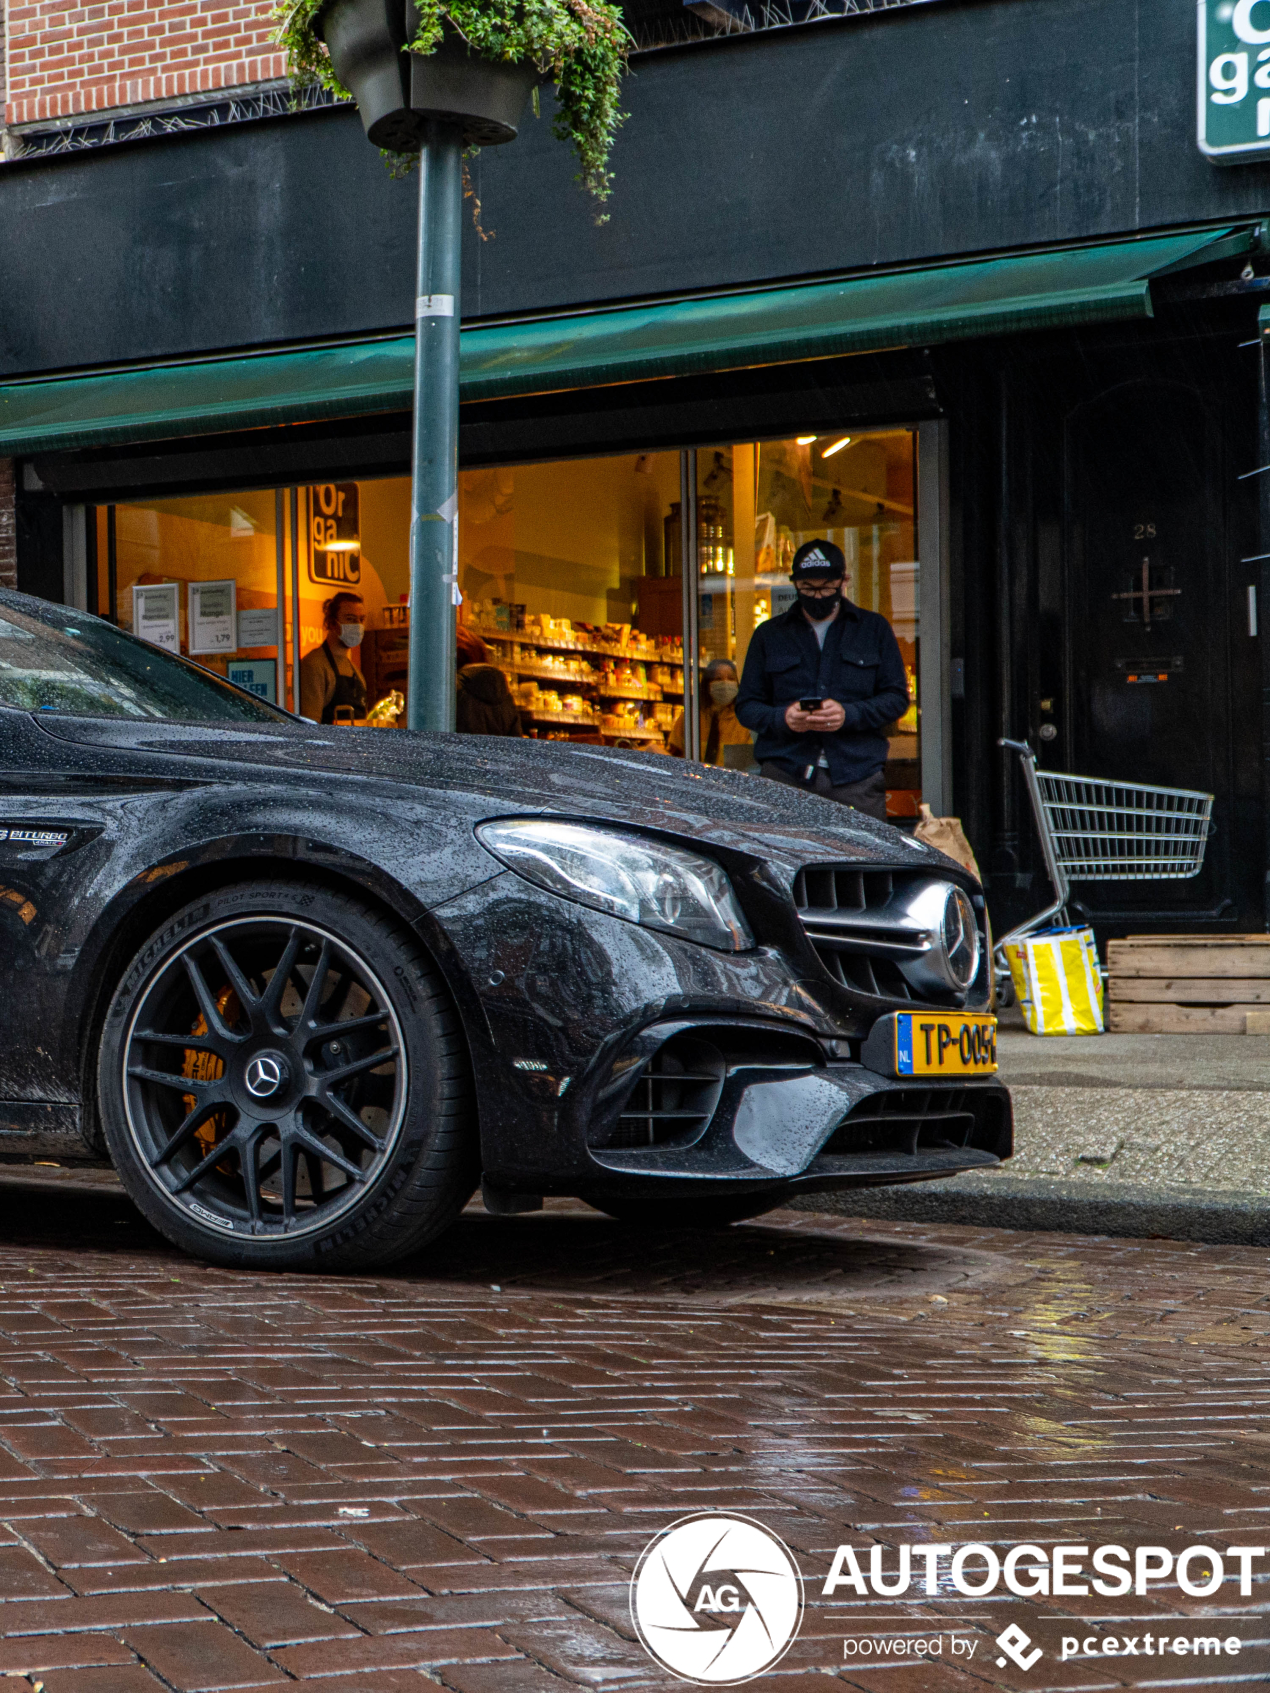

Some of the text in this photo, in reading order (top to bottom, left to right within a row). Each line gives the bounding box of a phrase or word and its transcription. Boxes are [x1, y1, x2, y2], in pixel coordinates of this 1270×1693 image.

[1133, 523, 1157, 540] 28
[800, 560, 831, 569] adidas
[159, 634, 175, 644] 2,99
[215, 633, 231, 644] 1,79
[231, 669, 254, 683] HIER
[9, 830, 68, 841] BITURBO
[217, 893, 244, 906] PILOT
[249, 891, 285, 900] SPORT
[125, 905, 207, 991] MICHELIN
[899, 1050, 912, 1063] NL
[319, 1169, 409, 1253] MICHELIN
